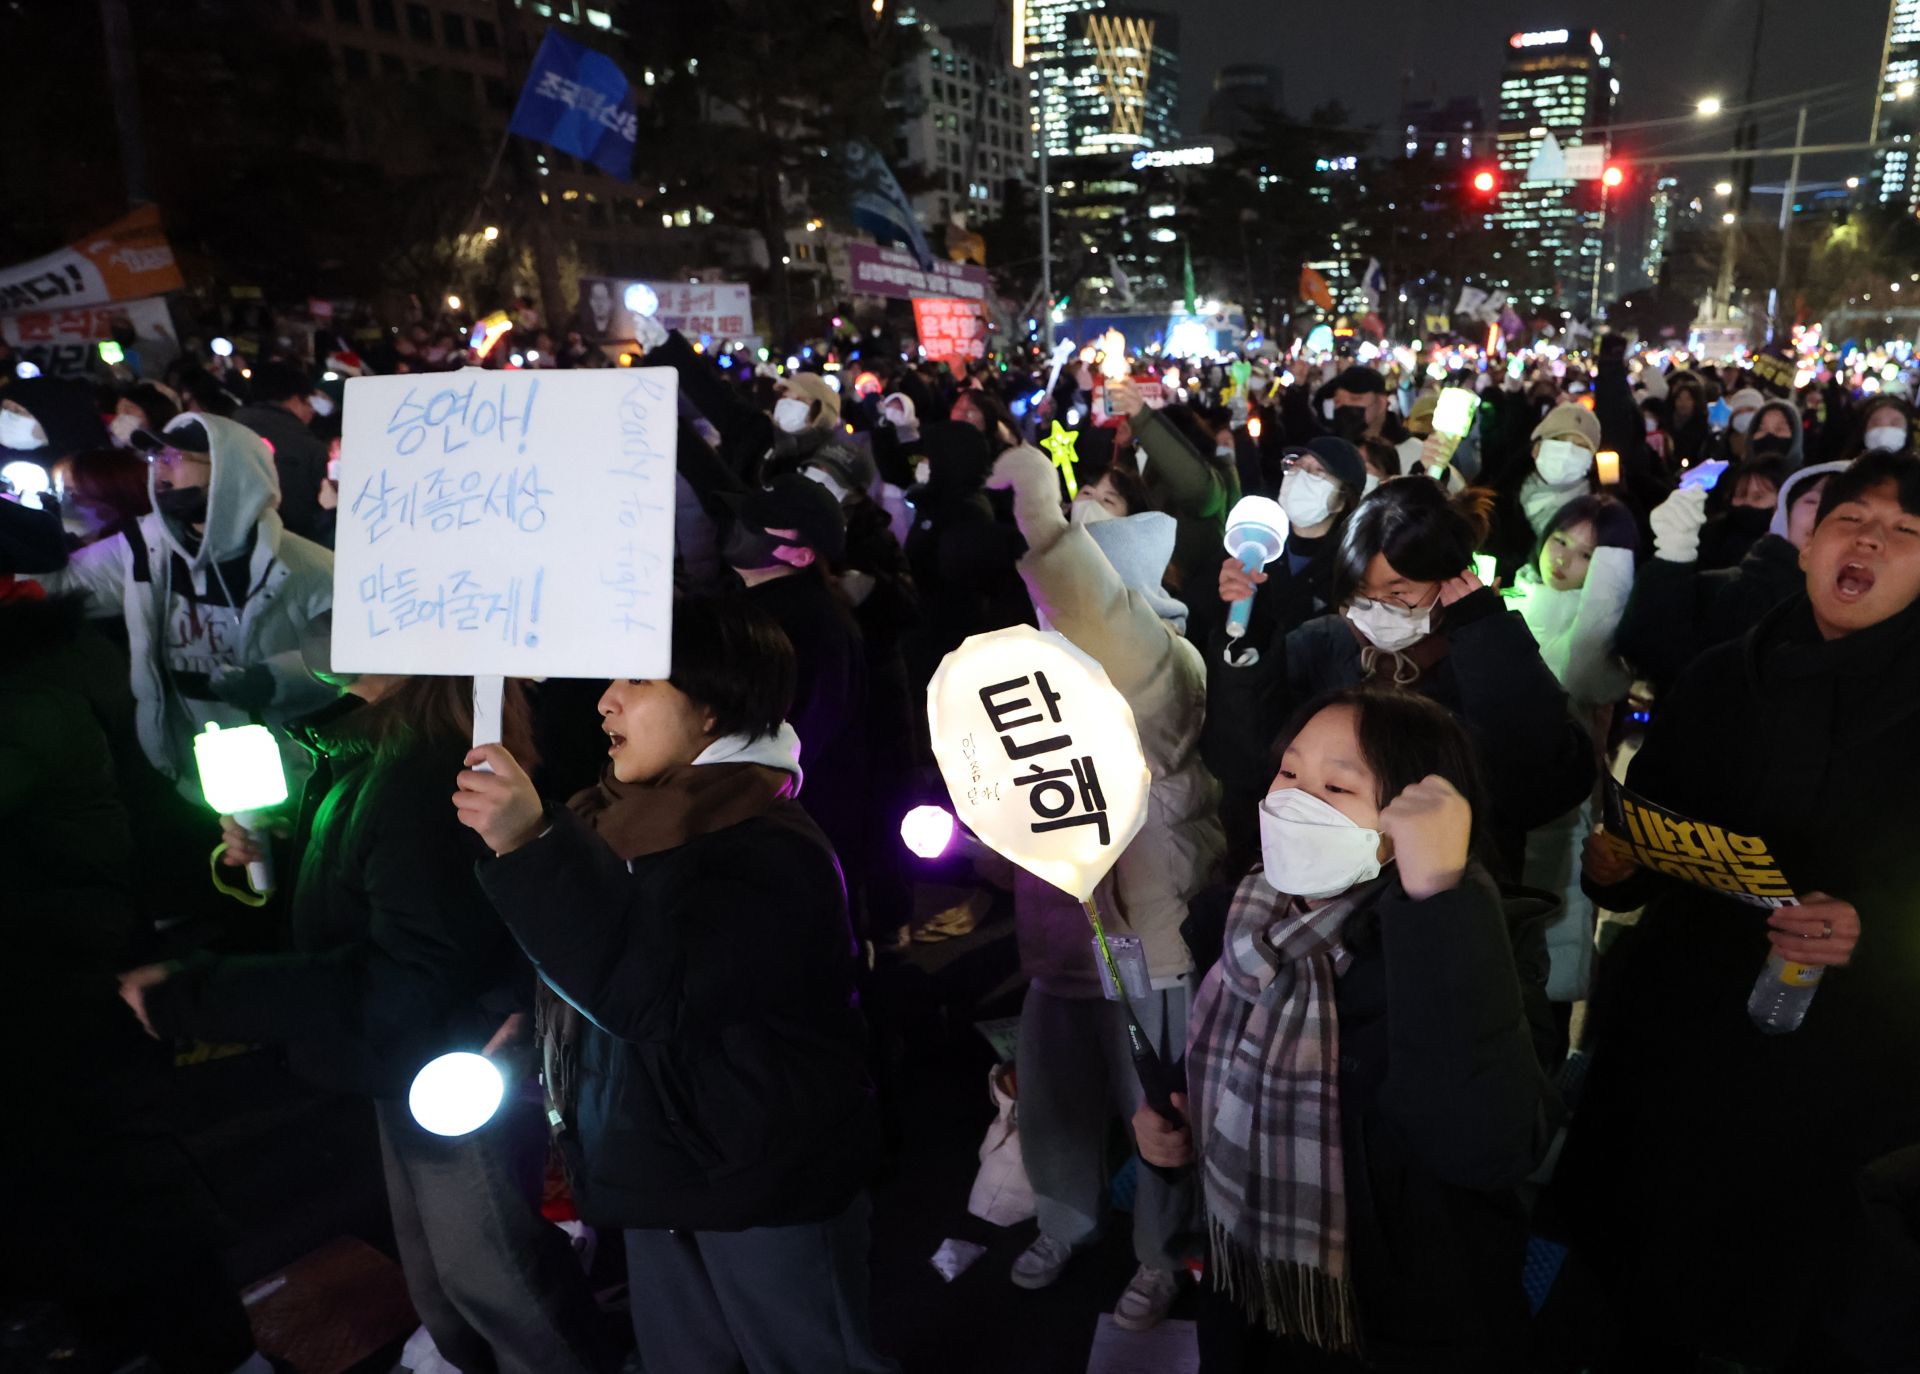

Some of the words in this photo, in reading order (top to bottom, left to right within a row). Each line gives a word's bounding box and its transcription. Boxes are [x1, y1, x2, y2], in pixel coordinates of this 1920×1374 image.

[387, 378, 541, 455] 승연아!
[618, 493, 666, 529] to
[600, 541, 662, 634] fight
[978, 670, 1111, 846] 탄핵
